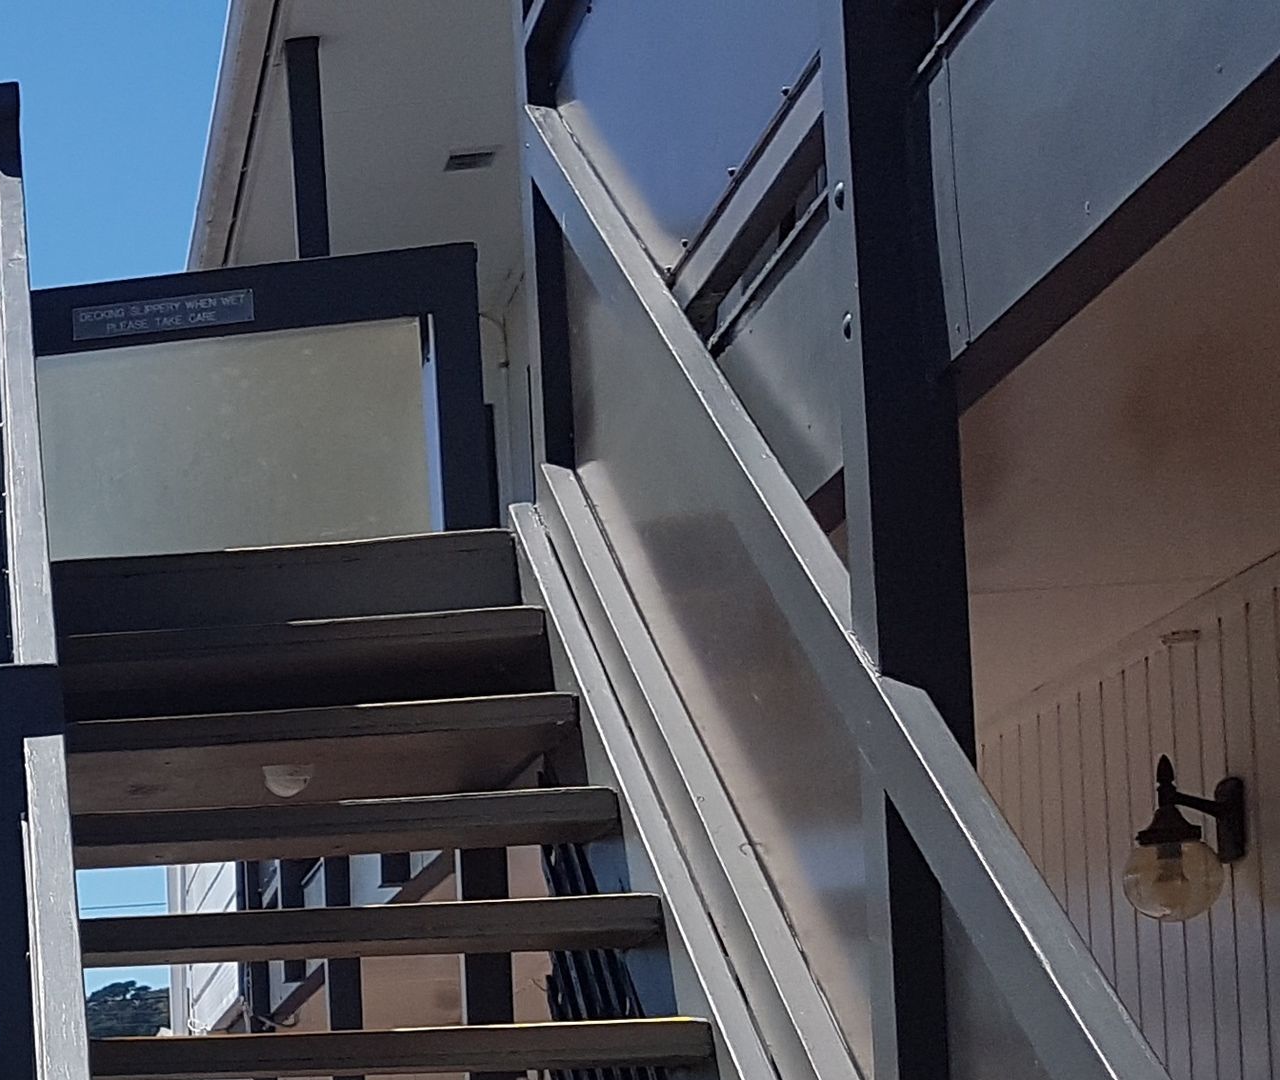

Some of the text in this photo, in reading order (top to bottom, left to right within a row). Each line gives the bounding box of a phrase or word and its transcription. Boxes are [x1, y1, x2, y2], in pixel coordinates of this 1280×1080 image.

[130, 302, 180, 317] SLIPPERY
[185, 298, 217, 310] WHEN
[221, 294, 245, 306] WET
[106, 311, 217, 333] PLEASE TAKE CARE
